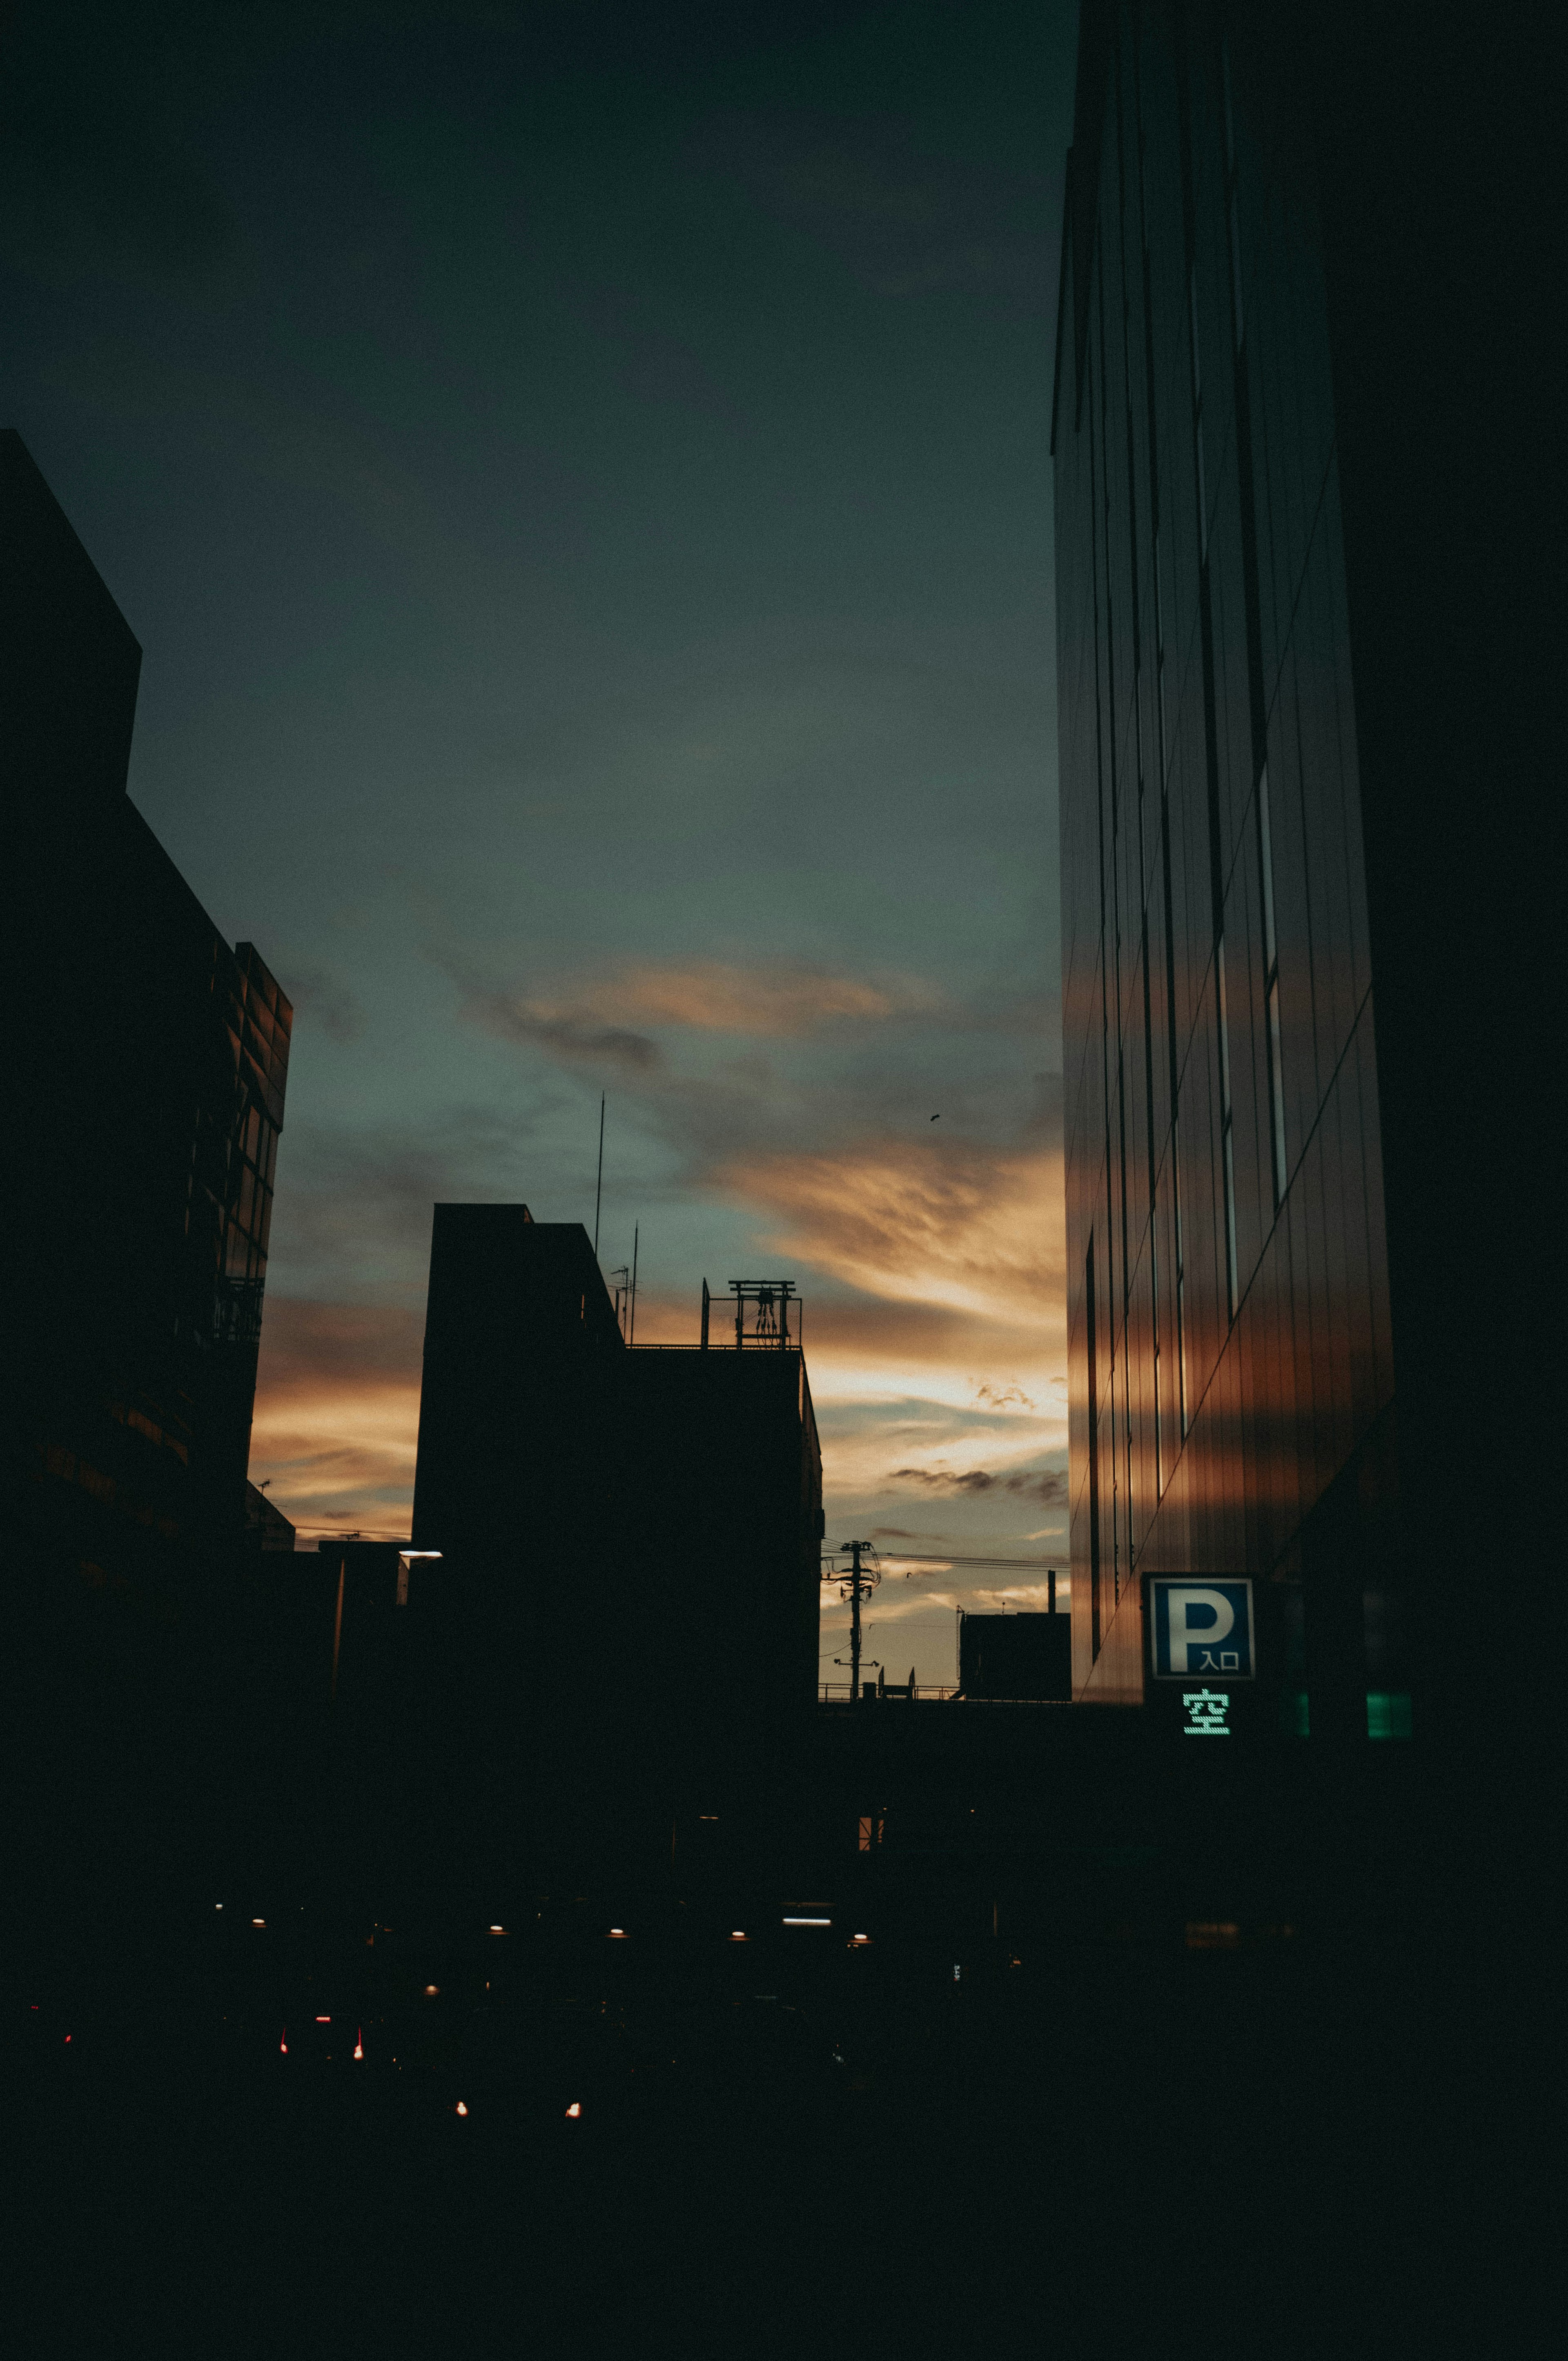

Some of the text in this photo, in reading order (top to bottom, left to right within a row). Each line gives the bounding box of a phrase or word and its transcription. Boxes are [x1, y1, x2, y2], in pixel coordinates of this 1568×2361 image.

[1168, 1588, 1234, 1672] P
[1200, 1651, 1239, 1671] 入口
[1183, 1689, 1230, 1734] 空
